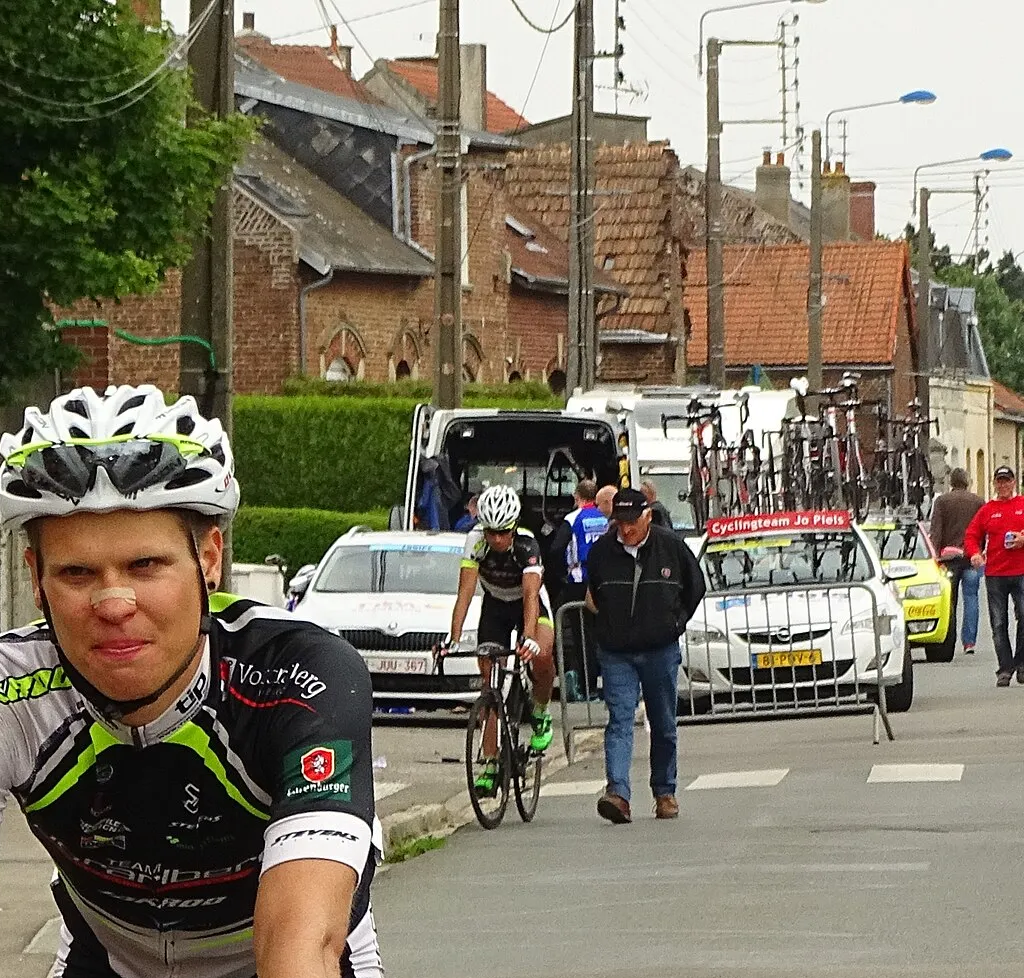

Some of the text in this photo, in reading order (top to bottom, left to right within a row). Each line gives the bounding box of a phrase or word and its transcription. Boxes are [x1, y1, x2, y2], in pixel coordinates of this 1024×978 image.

[712, 517, 789, 535] Cyclingteam
[794, 515, 808, 525] Jo
[270, 829, 359, 847] STEVENS
